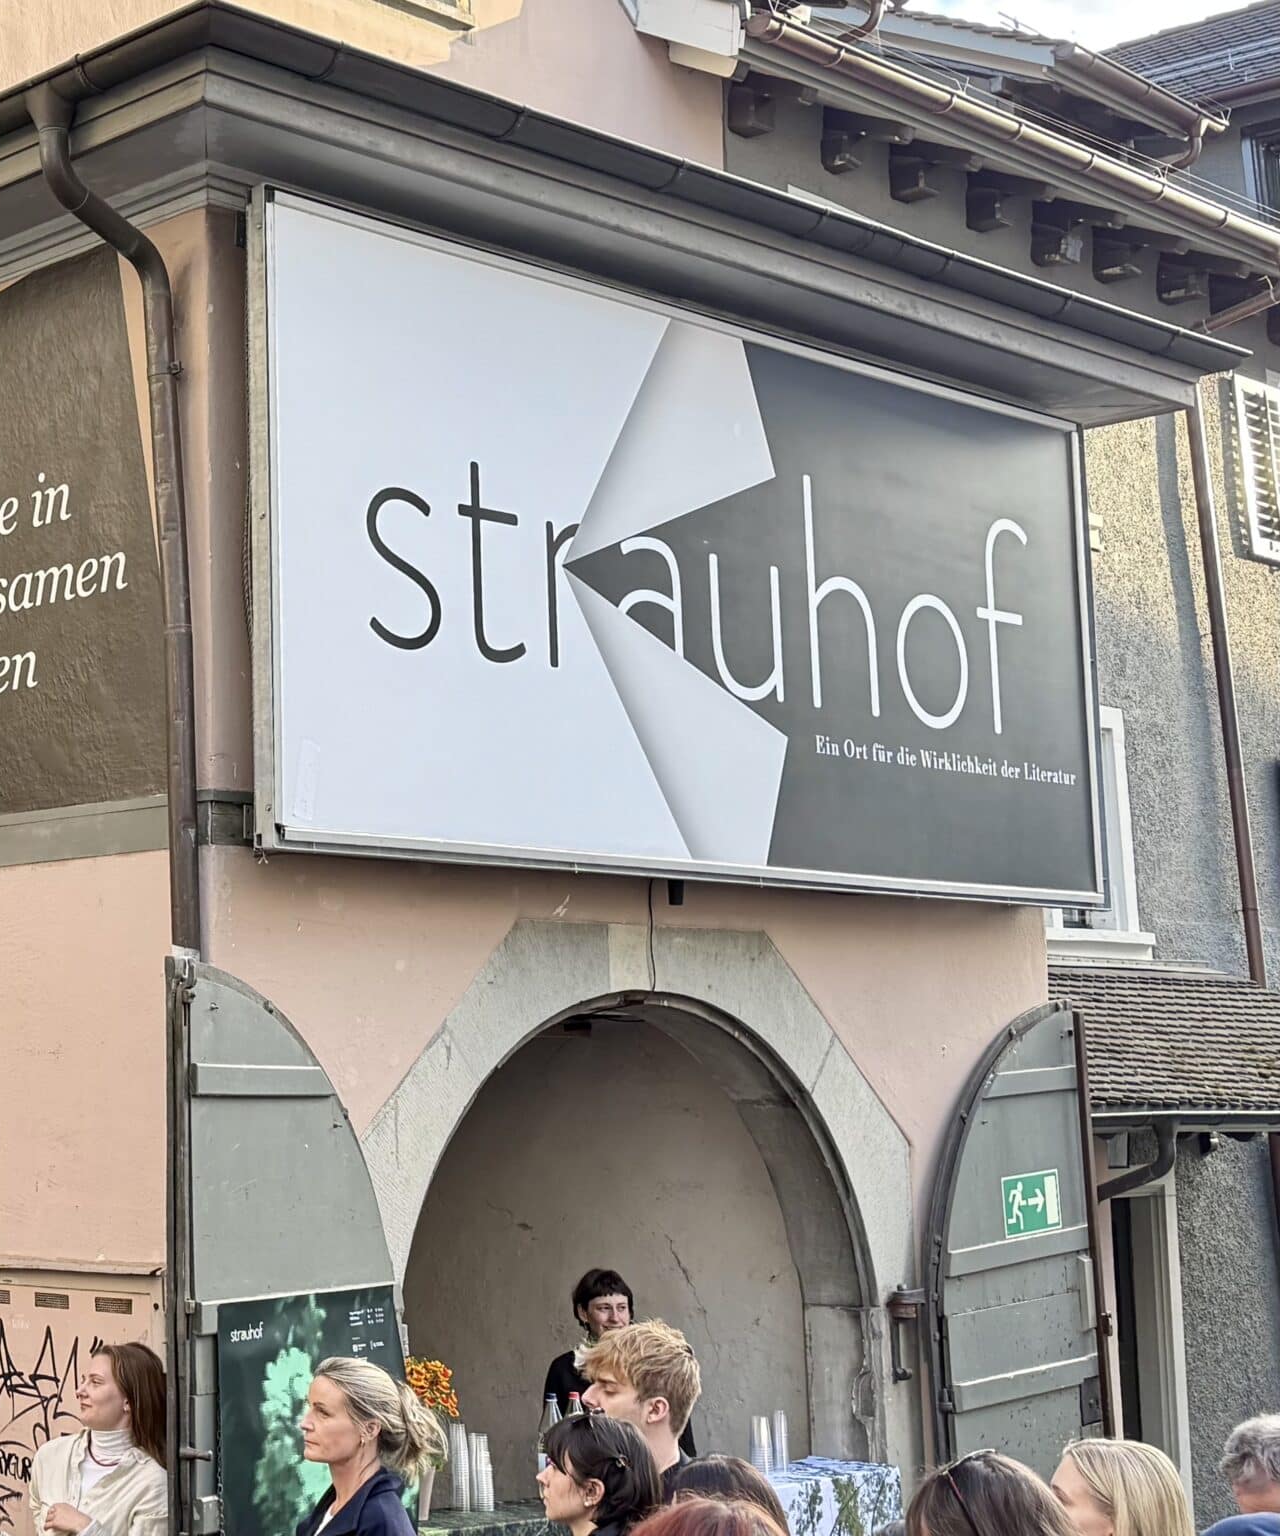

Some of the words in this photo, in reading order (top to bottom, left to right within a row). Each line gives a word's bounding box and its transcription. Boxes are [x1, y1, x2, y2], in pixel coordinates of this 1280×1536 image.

[31, 472, 71, 528] in
[366, 461, 1028, 735] strauhof
[815, 734, 840, 757] Ein
[843, 739, 869, 760] Ort
[872, 742, 894, 764] für
[897, 746, 918, 767] die
[919, 749, 998, 777] Wirklichkeit
[1000, 759, 1021, 779] der
[1023, 762, 1077, 786] Literatur
[230, 1321, 264, 1343] strauhof
